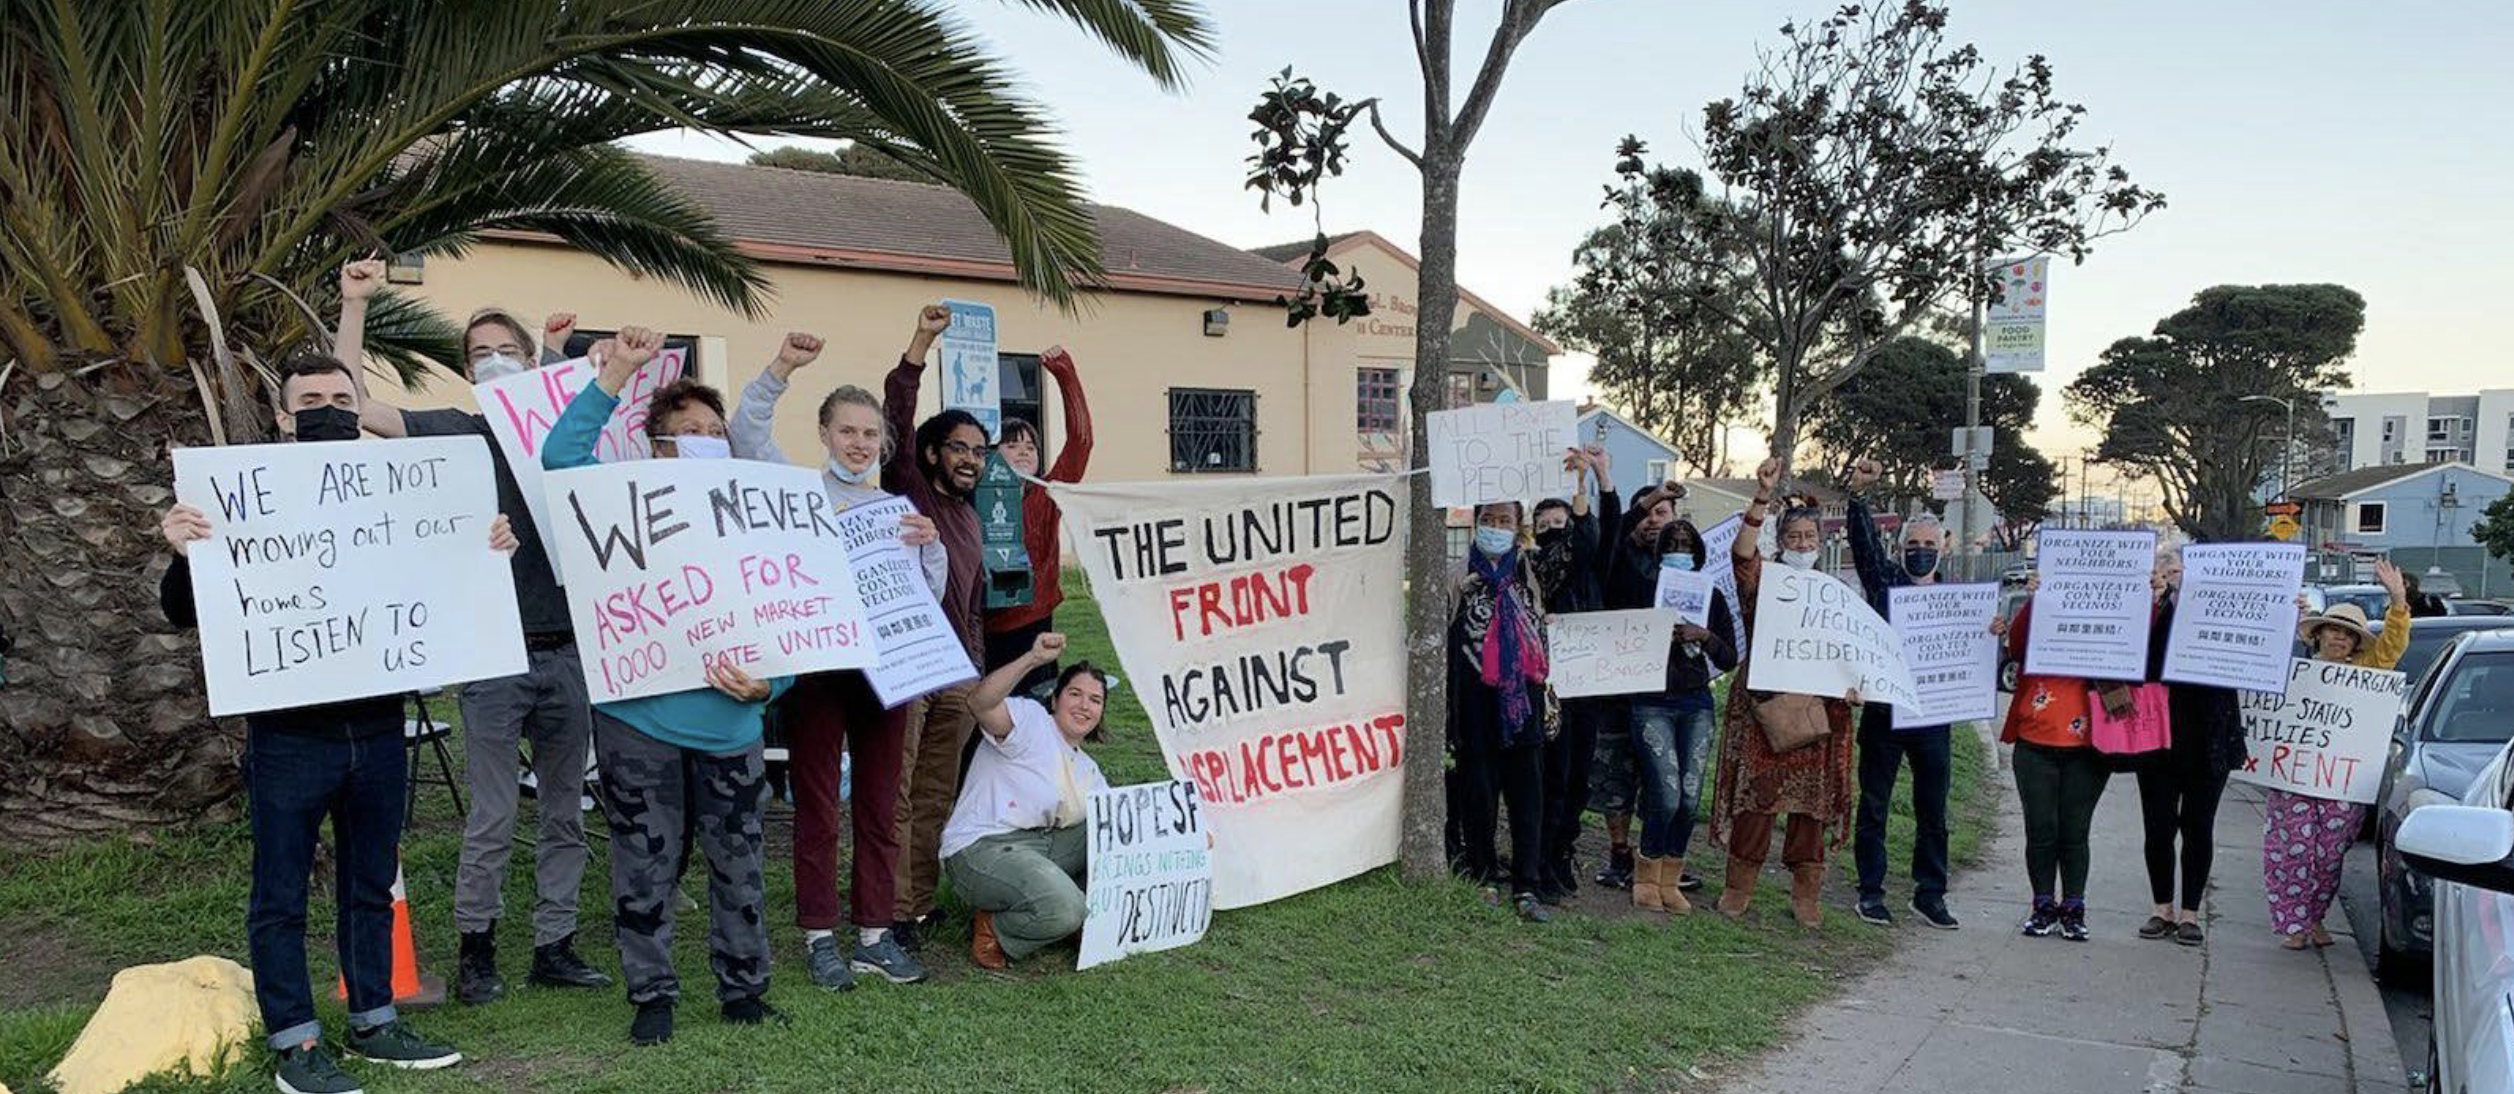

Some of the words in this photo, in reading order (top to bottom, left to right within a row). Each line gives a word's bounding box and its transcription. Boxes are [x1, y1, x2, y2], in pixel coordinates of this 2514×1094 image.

[1997, 334, 2034, 342] PANTRY
[2002, 326, 2030, 334] FOOD
[1436, 413, 1490, 440] ALL
[1451, 438, 1491, 471] TO
[1508, 428, 1561, 462] THE
[210, 467, 276, 523] WE
[318, 463, 373, 505] ARE
[388, 458, 446, 495] NOT
[1462, 460, 1573, 505] PEOPLE
[569, 480, 690, 571] WE
[707, 478, 839, 538] NEVER
[1094, 519, 1187, 580] THE
[1205, 490, 1395, 566] UNITED
[226, 529, 336, 568] moving
[353, 513, 396, 546] out
[415, 515, 474, 539] our
[2043, 537, 2114, 549] ORGANIZE
[2118, 539, 2152, 550] WITH
[2080, 548, 2116, 558] YOUR
[2188, 550, 2262, 560] ORGANIZE
[2266, 551, 2302, 562] WITH
[2054, 557, 2139, 569] NEIGHBORS!
[2201, 566, 2288, 579] NEIGHBORS!
[2227, 559, 2264, 568] YOUR
[235, 578, 327, 617] homes
[595, 565, 714, 650] ASKED
[740, 553, 819, 594] FOR
[1170, 564, 1315, 641] FRONT
[1776, 575, 1850, 608] STOP
[1894, 592, 1958, 605] ORGANIZE
[1962, 590, 1995, 600] WITH
[1927, 600, 1962, 610] YOUR
[2062, 600, 2123, 611] VECINOS!
[2065, 592, 2092, 600] CON
[2096, 592, 2121, 601] TUS
[2208, 600, 2236, 610] CON
[2242, 601, 2268, 612] TUS
[1907, 608, 1983, 622] NEIGHBORS!
[2204, 608, 2270, 622] VECINOS!
[245, 607, 367, 676] LISTEN
[386, 602, 428, 636] TO
[601, 641, 667, 697] 1,000
[687, 612, 735, 647] NEW
[753, 597, 834, 628] MARKET
[777, 621, 860, 656] UNITS!
[1919, 643, 1943, 653] CON
[1948, 641, 1969, 649] TUS
[1162, 640, 1350, 728] AGAINST
[2321, 665, 2406, 696] CHARGING
[2242, 689, 2353, 729] IXED-STATUS
[2244, 714, 2331, 749] MILIES
[2270, 744, 2361, 795] RENT
